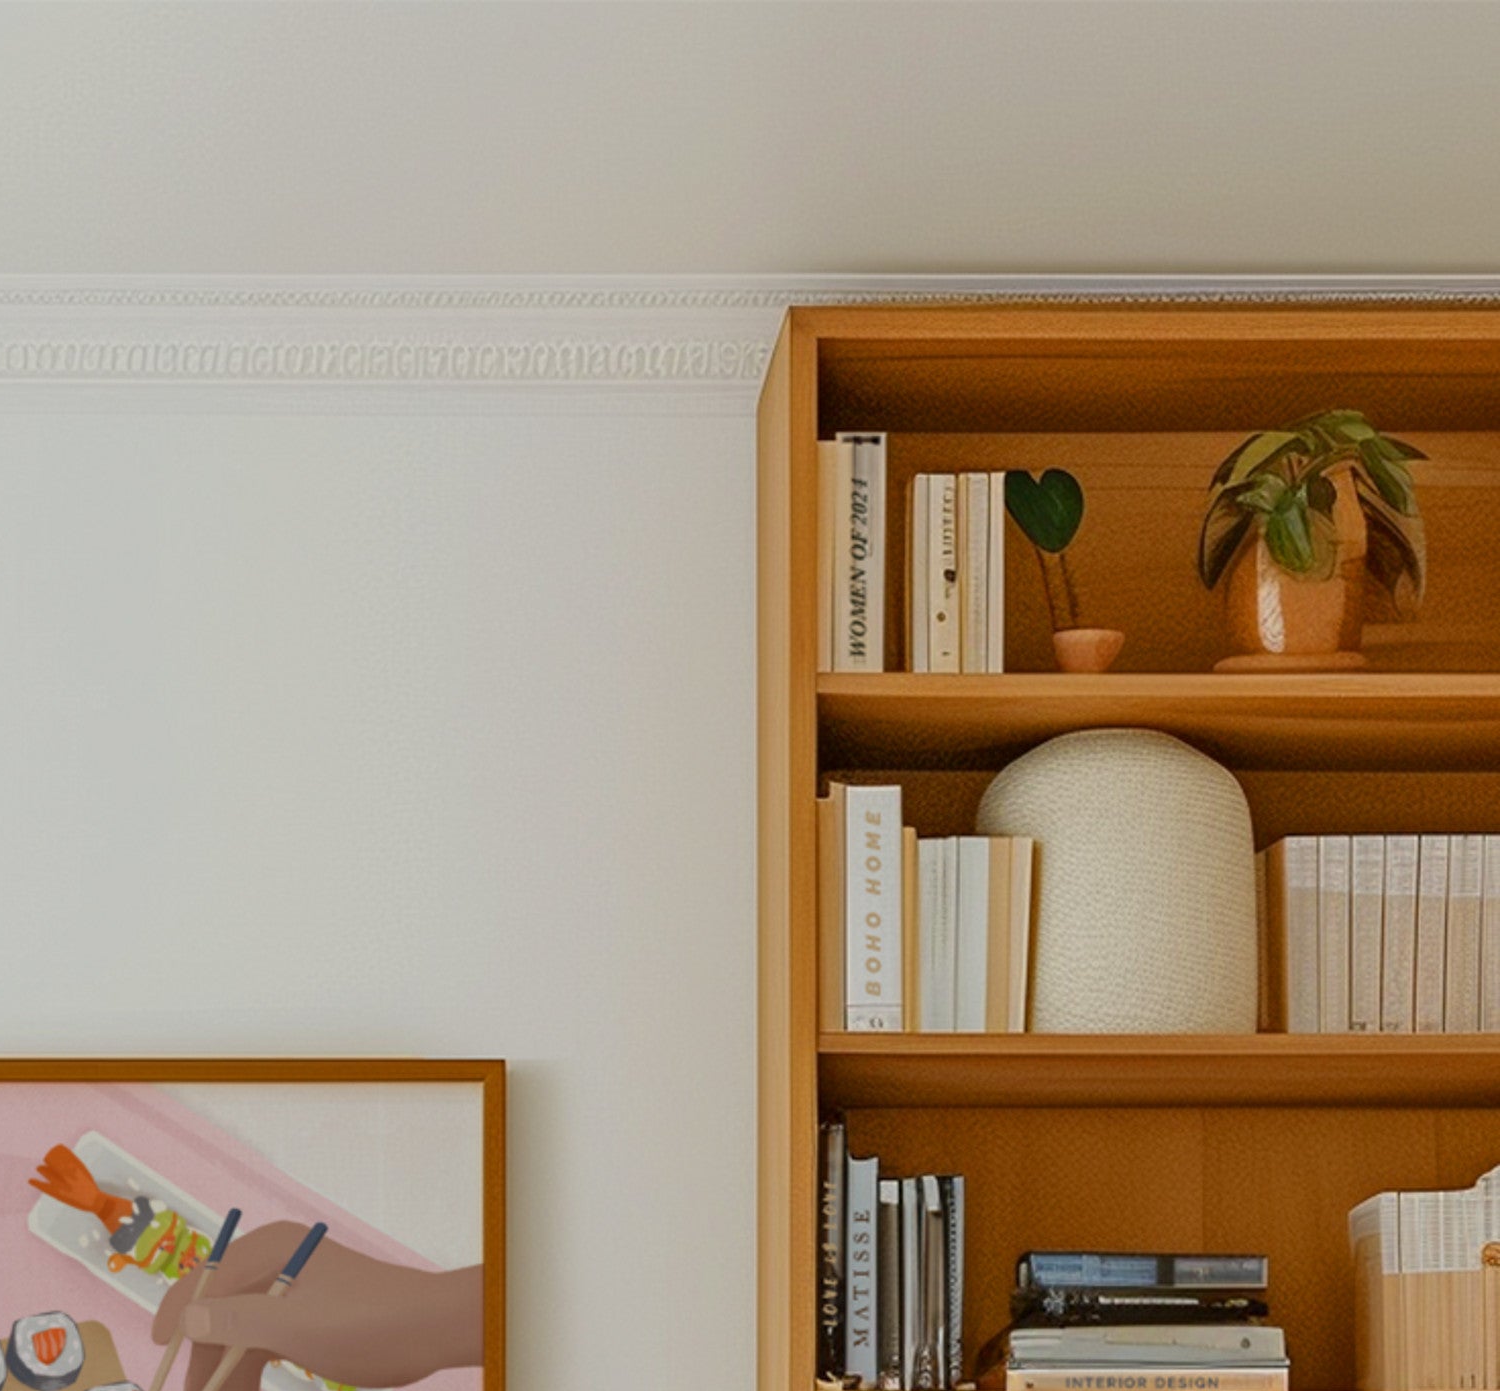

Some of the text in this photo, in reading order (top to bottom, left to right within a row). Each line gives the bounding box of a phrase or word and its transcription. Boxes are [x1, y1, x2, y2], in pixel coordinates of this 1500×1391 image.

[849, 477, 869, 657] WOMEN OF 2024
[865, 810, 882, 997] BOHO HOME
[822, 1278, 838, 1327] LOVE
[852, 1209, 871, 1348] MATISSE
[1065, 1376, 1220, 1390] INTERIOR DESIGN
